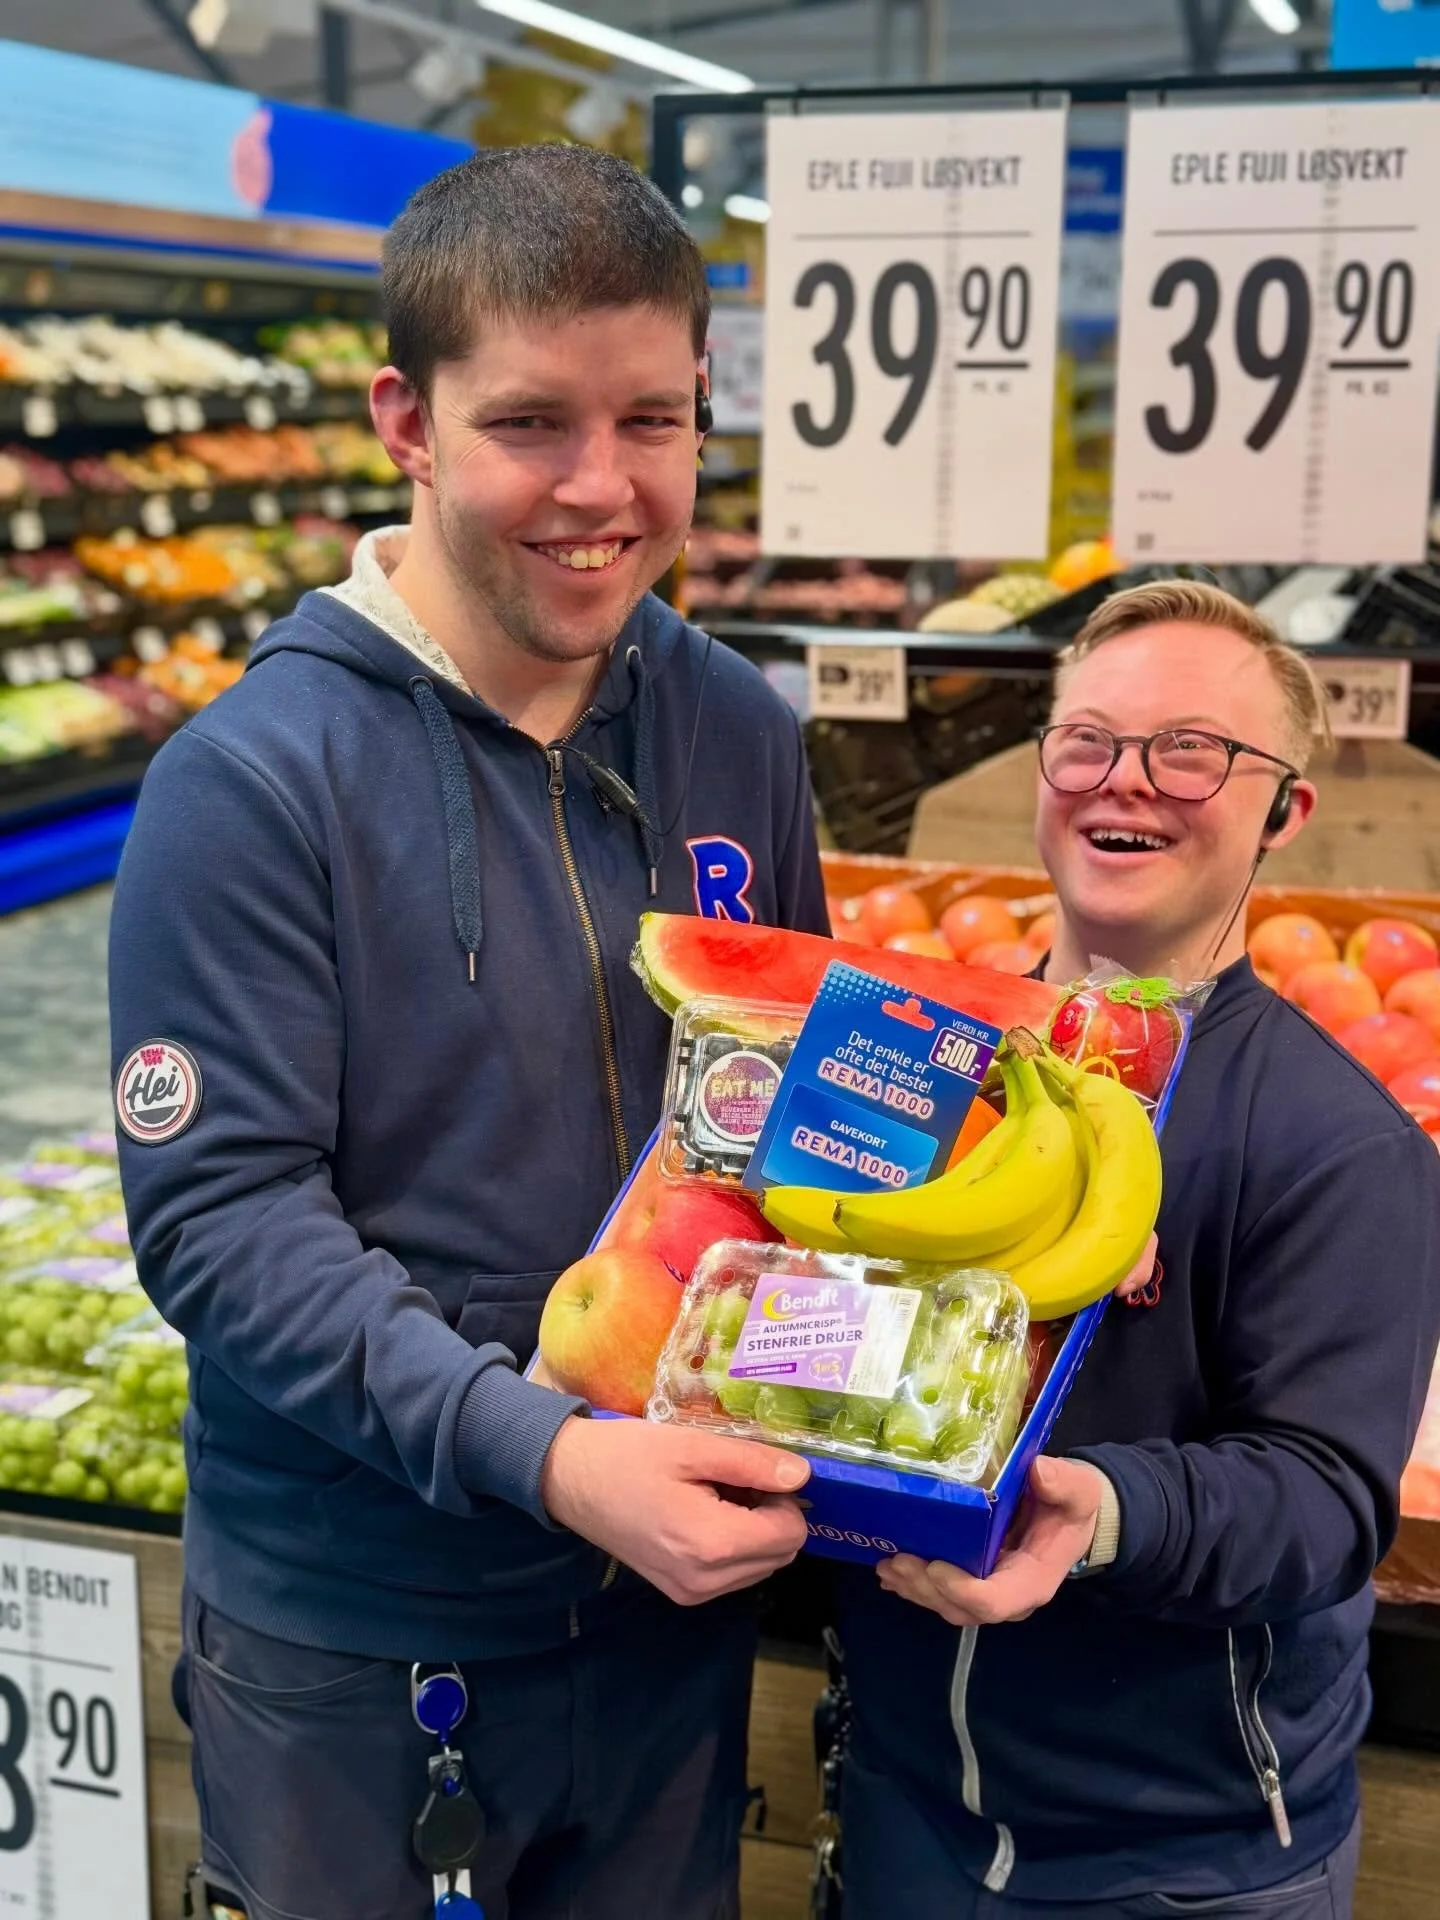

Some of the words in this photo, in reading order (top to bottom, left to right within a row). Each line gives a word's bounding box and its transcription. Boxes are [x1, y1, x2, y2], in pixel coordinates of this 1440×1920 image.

[807, 158, 859, 190] EPLE
[868, 158, 914, 190] FUJI
[921, 155, 1021, 190] LØSVEKT
[1171, 152, 1228, 185] EPLE
[1237, 150, 1288, 183] FUJI
[1296, 146, 1407, 182] LØSVEKT
[791, 259, 939, 448] 39
[961, 265, 1031, 352] 90
[1144, 256, 1312, 455] 39
[1335, 260, 1413, 352] 90
[685, 835, 754, 924] R
[952, 1019, 976, 1036] VERDI
[976, 1029, 990, 1041] KR
[835, 1046, 864, 1066] ofte
[865, 1055, 891, 1077] det
[890, 1068, 934, 1094] beste!
[847, 1030, 874, 1051] Det
[874, 1042, 912, 1068] enkle
[913, 1060, 931, 1076] er
[936, 1033, 981, 1075] 500,-
[126, 1066, 180, 1110] Hei
[711, 1079, 747, 1099] EAT
[750, 1078, 775, 1098] ME
[819, 1058, 881, 1099] REMA
[885, 1086, 933, 1118] 1000
[793, 1128, 853, 1166] REMA
[859, 1154, 906, 1185] 1000
[830, 1120, 888, 1150] GAVEKORT
[747, 1333, 812, 1352] STENFRIE
[815, 1329, 863, 1345] DRUER
[26, 1566, 110, 1608] BENDIT
[48, 1690, 117, 1778] 90
